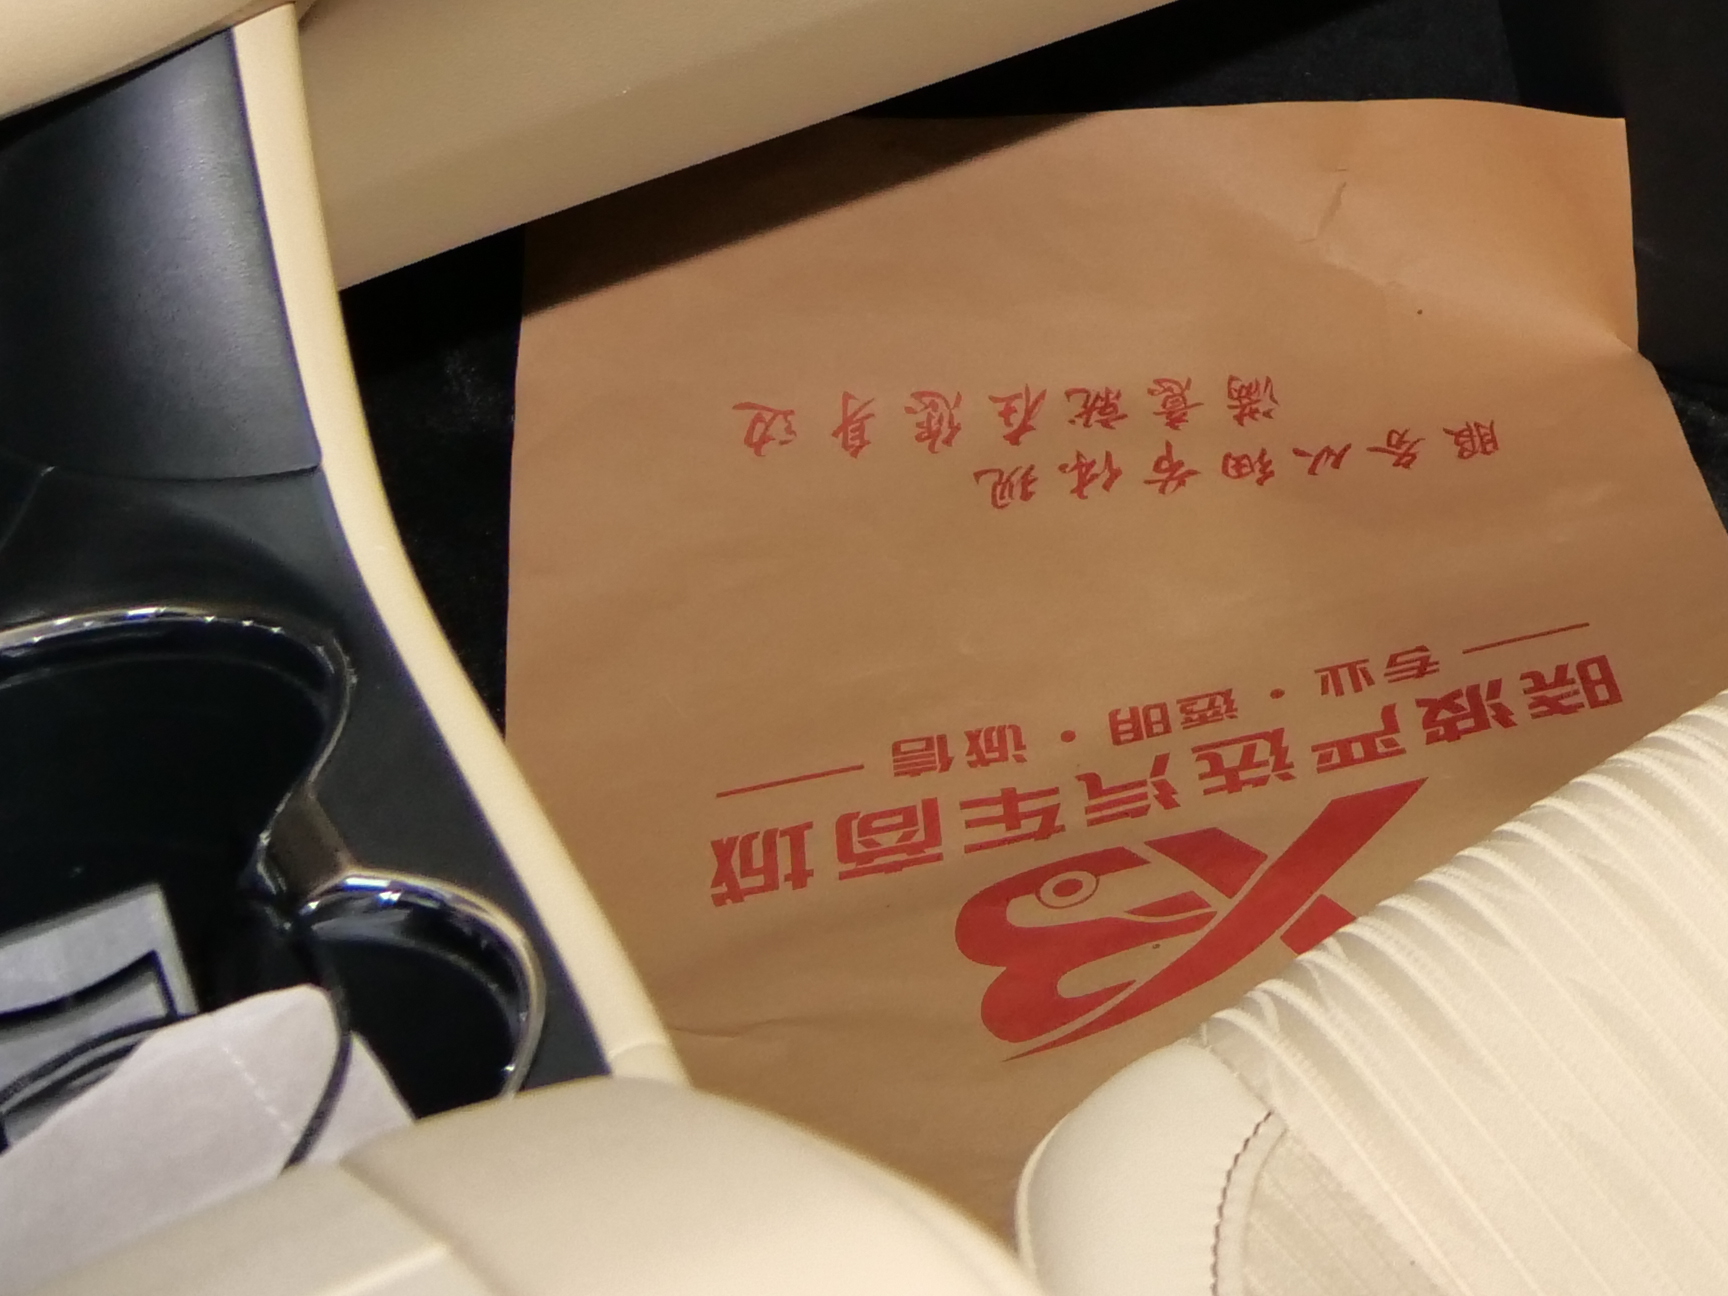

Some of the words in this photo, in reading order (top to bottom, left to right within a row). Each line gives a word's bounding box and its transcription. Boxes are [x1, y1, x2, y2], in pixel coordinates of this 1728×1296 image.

[735, 375, 1278, 458] 满意就在您身边
[973, 422, 1501, 511] 服务从细节体现
[710, 654, 1624, 908] 晓波严选汽车商城
